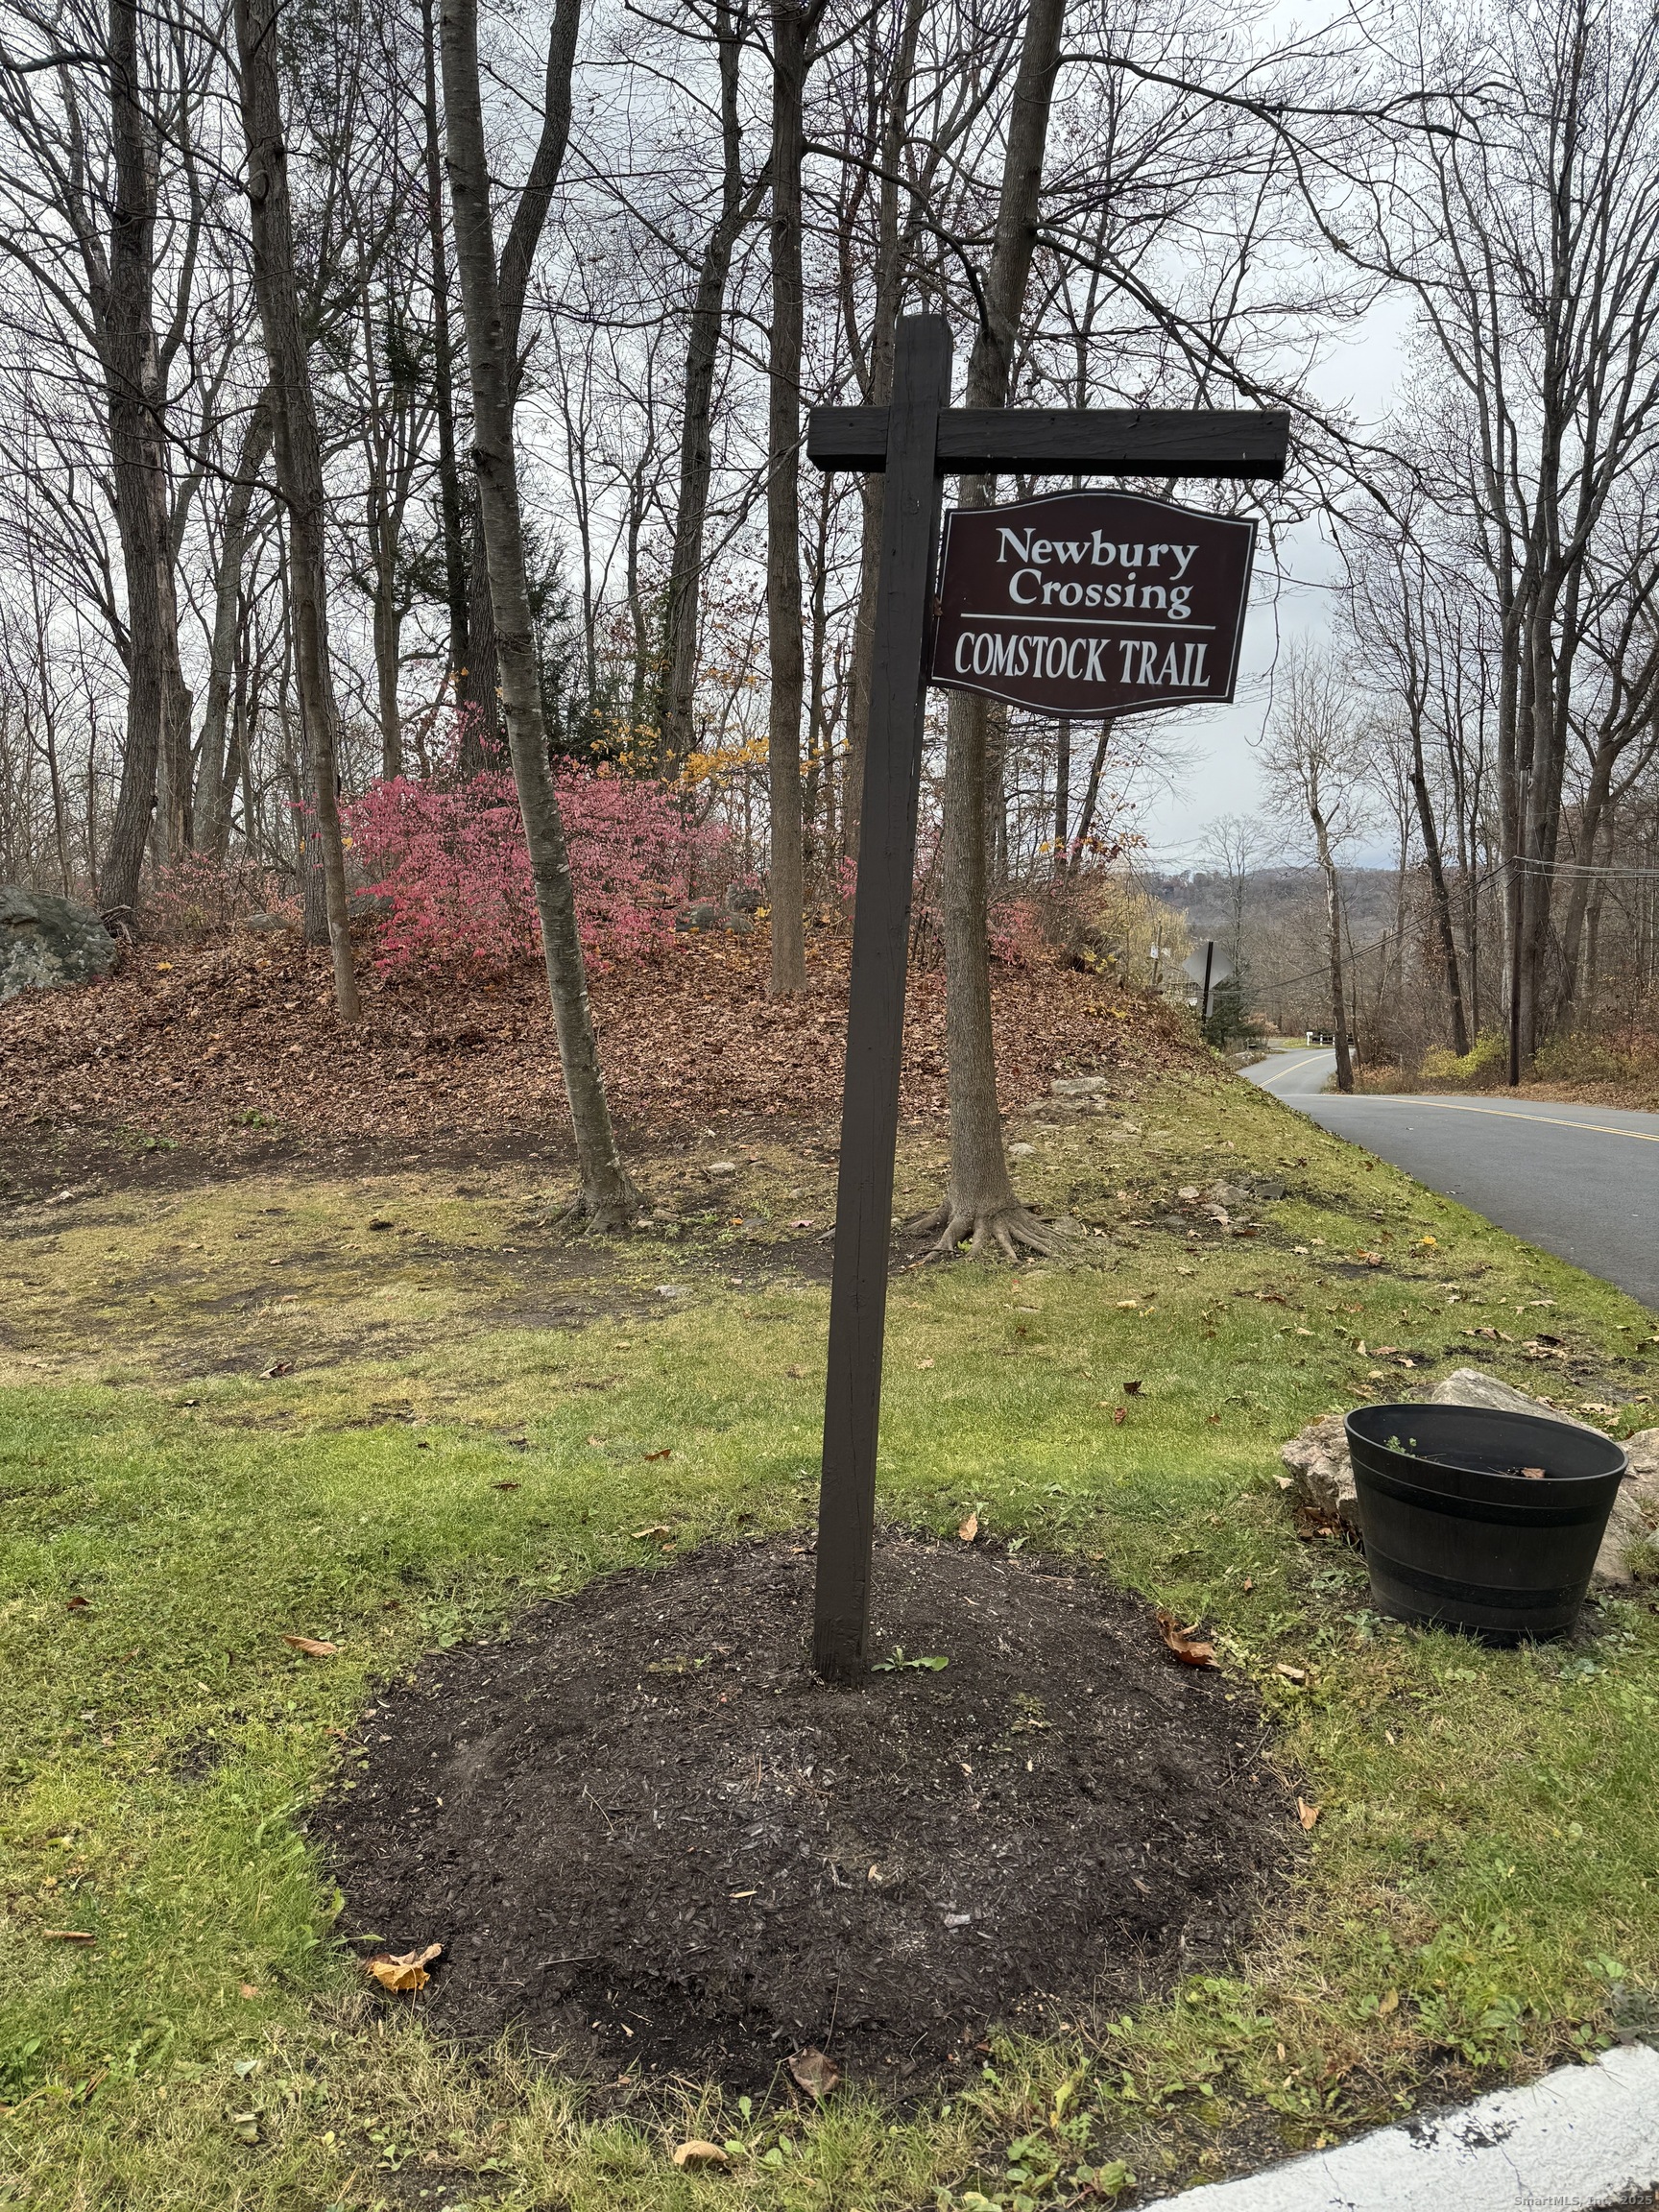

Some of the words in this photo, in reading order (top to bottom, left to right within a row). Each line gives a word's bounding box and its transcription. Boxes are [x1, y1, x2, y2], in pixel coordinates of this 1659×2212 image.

[996, 527, 1200, 580] Newbury
[1008, 567, 1194, 620] Crossing
[954, 632, 1112, 683] COMSTOCK
[1118, 639, 1211, 687] TRAIL
